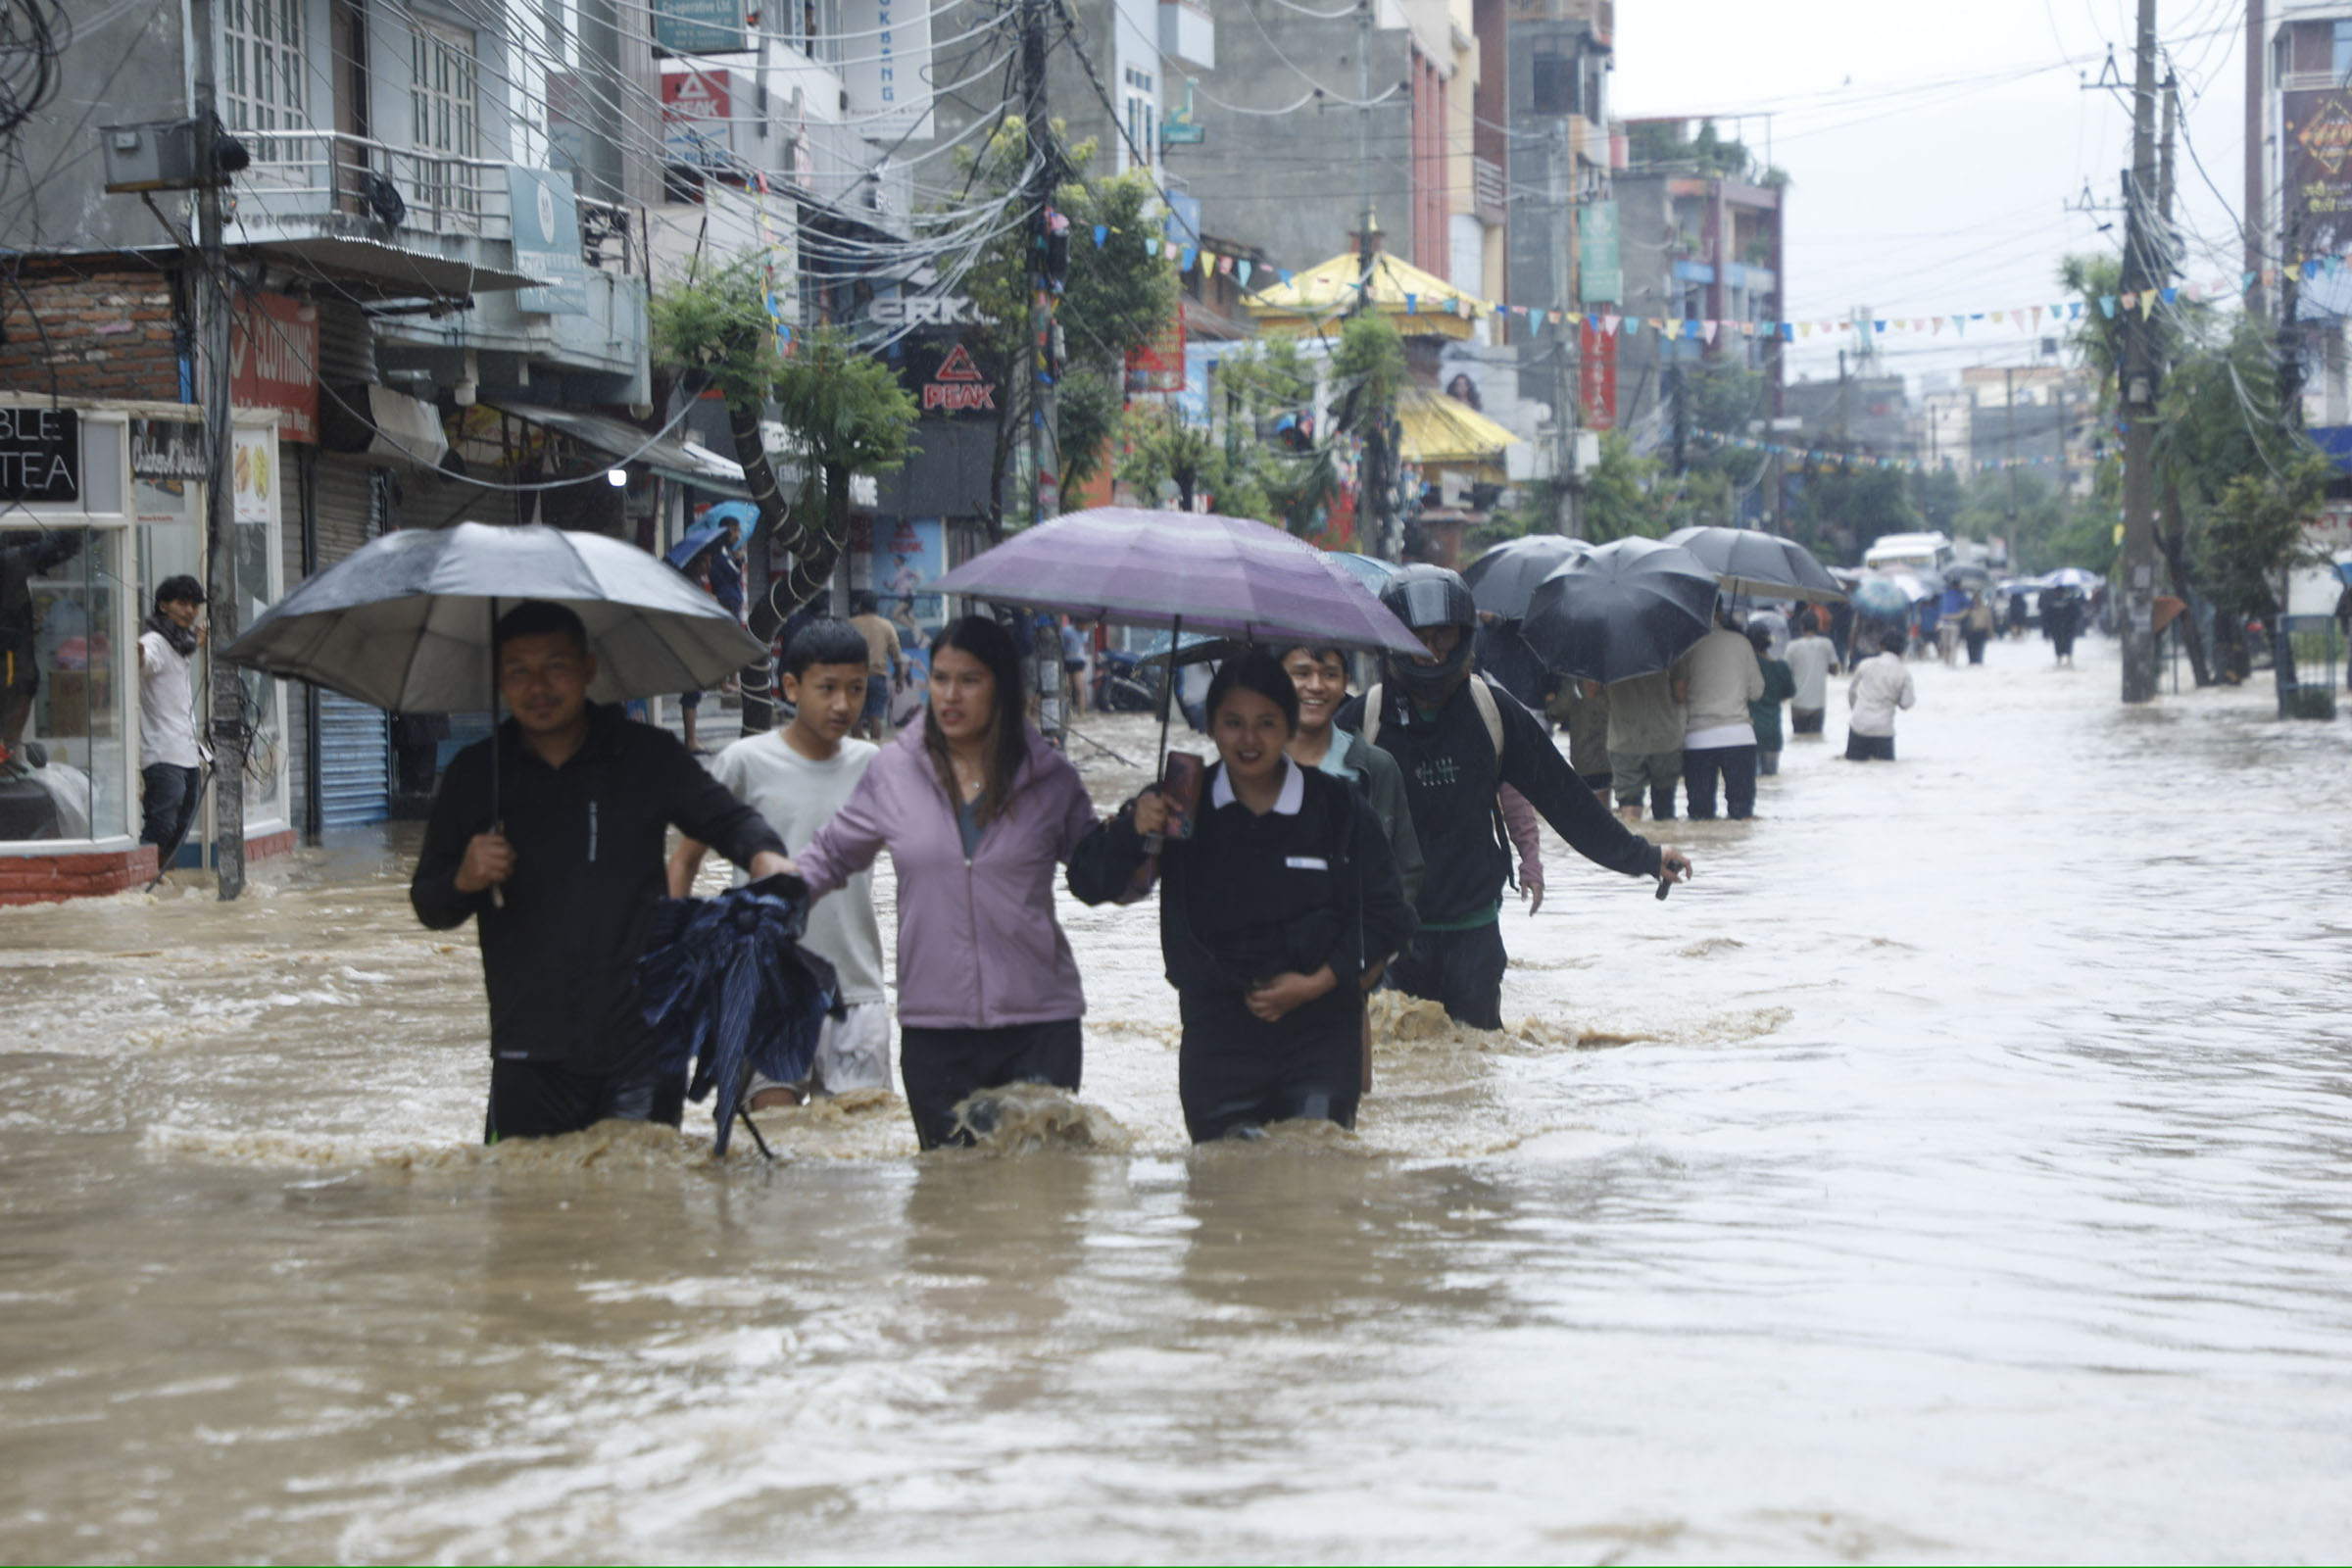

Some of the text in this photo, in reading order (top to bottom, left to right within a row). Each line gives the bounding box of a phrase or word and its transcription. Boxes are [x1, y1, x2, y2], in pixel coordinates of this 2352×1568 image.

[255, 314, 313, 388] CLOTHING
[922, 383, 997, 410] PEAK
[0, 451, 76, 491] TEA
